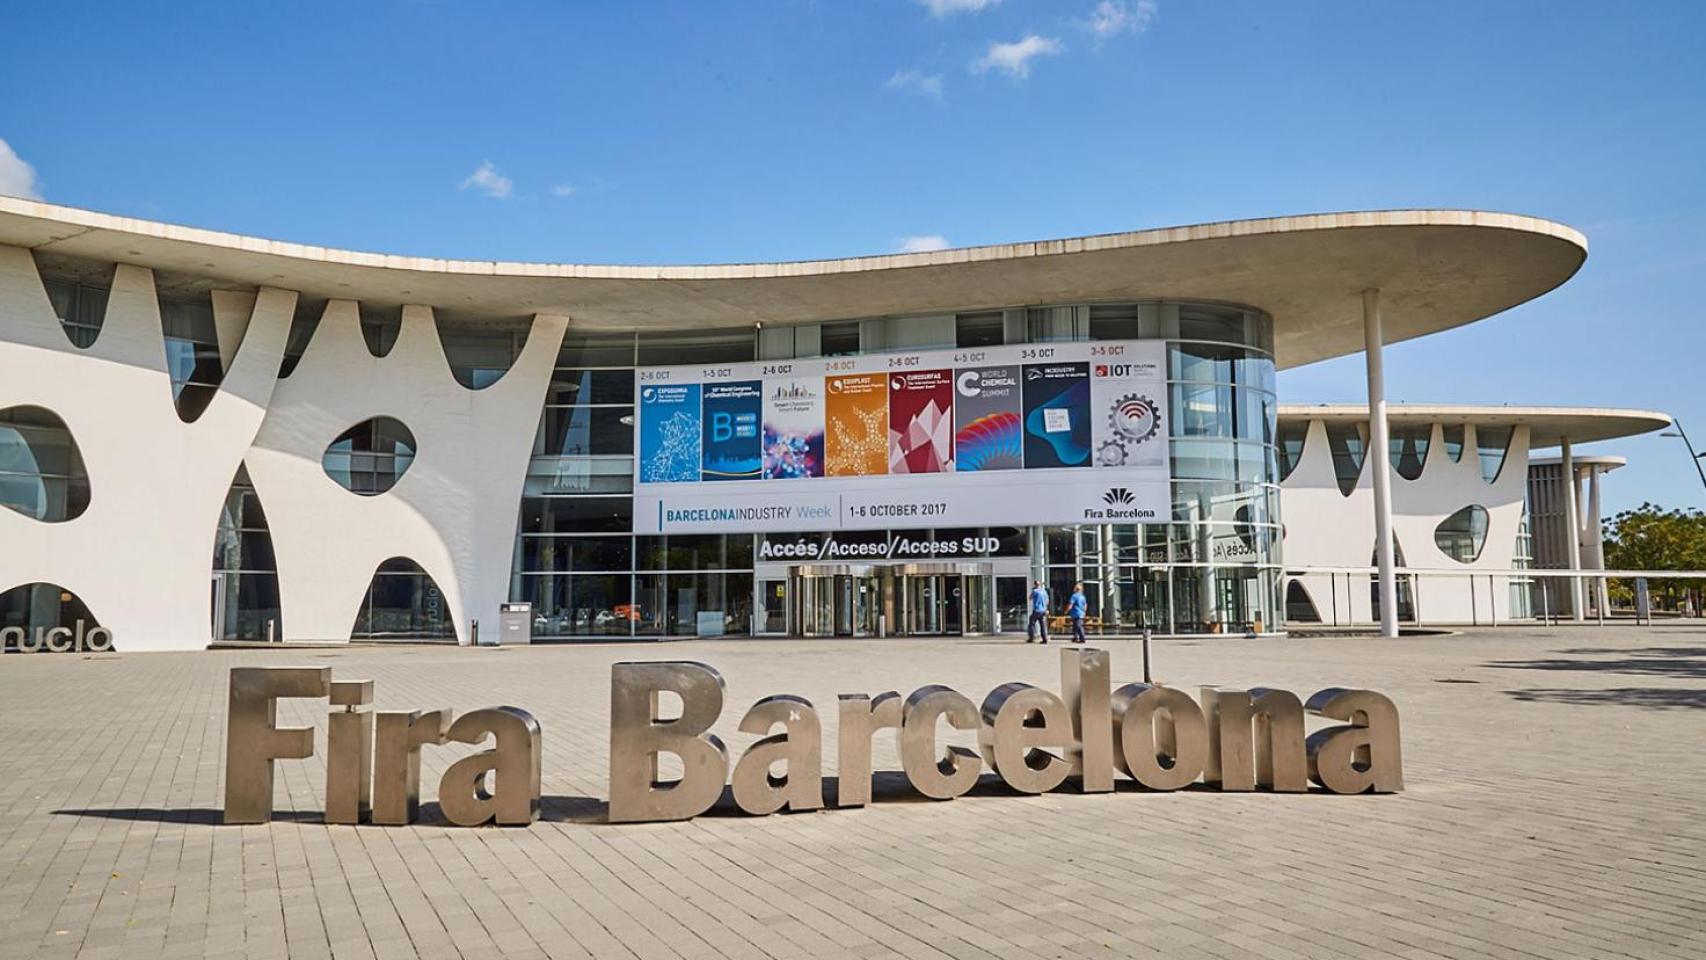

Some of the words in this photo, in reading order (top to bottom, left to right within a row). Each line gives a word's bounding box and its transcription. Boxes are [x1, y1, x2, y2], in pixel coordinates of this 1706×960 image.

[1021, 349, 1036, 359] 3-5
[1039, 348, 1054, 358] OCT
[1091, 346, 1106, 356] 3-5
[1108, 346, 1124, 356] OCT
[888, 357, 902, 367] 2-6
[903, 356, 919, 366] OCT
[954, 354, 967, 362] 4-5
[970, 352, 985, 362] OCT
[763, 366, 776, 375] 2-6
[777, 364, 792, 374] OCT
[840, 360, 855, 370] OCT
[1110, 364, 1132, 377] IOT
[656, 370, 670, 380] OCT
[703, 369, 716, 378] 1-5
[717, 368, 732, 378] OCT
[981, 370, 1008, 379] WORLD
[981, 377, 1017, 387] CHEMICAL
[981, 388, 1010, 398] SUMMIT
[796, 505, 832, 519] Week
[850, 505, 866, 517] 1-6
[869, 504, 918, 517] OCTOBER
[921, 503, 947, 515] 2017
[1084, 508, 1104, 519] Fira
[1106, 508, 1155, 518] Barcelona
[962, 537, 1000, 553] SUD
[0, 619, 113, 653] nuclo
[223, 666, 542, 827] Fira
[608, 647, 1404, 823] Barcelona
